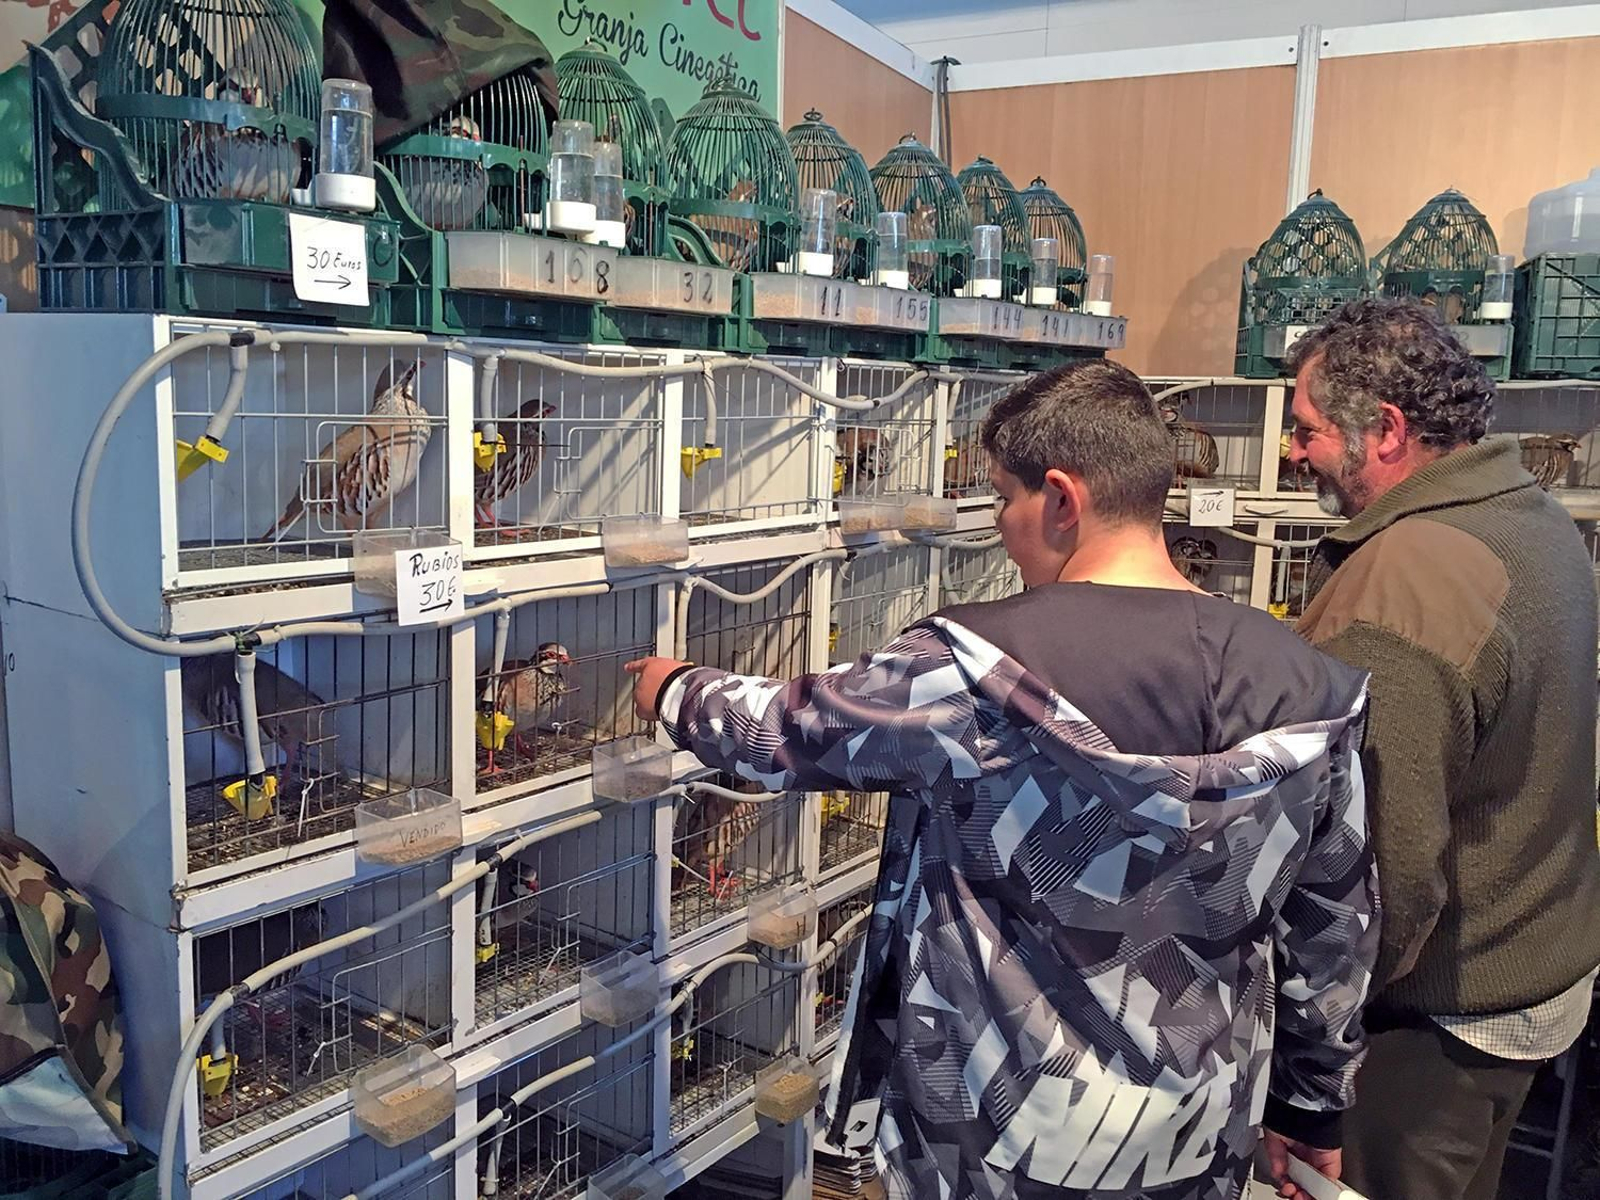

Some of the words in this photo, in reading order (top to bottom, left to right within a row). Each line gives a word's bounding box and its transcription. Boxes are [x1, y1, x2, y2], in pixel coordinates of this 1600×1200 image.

[558, 0, 649, 66] Granja
[306, 246, 331, 269] 30
[333, 251, 362, 270] Euros
[683, 272, 713, 304] 32
[820, 286, 842, 317] 11
[895, 296, 928, 322] 155
[993, 304, 1022, 331] 144
[1042, 314, 1069, 338] 141
[1099, 321, 1126, 342] 169
